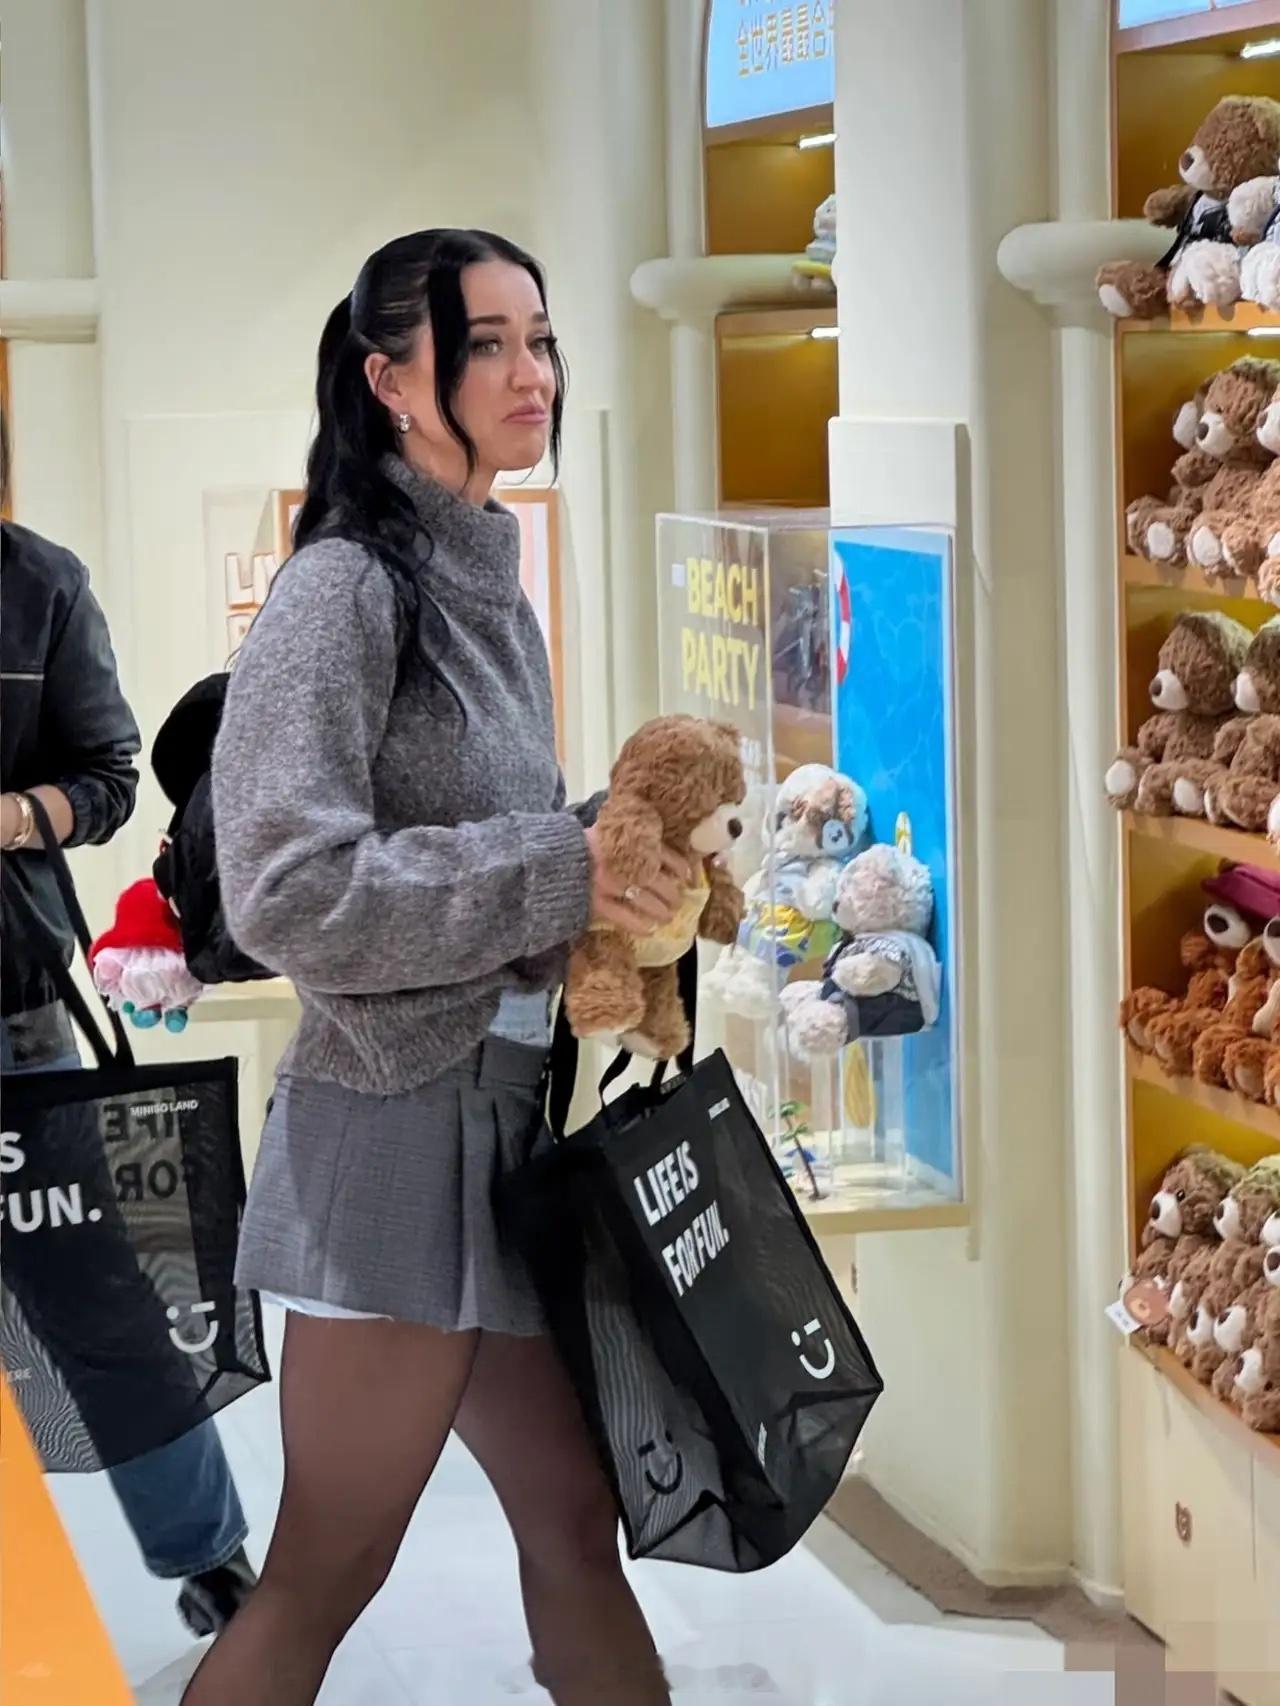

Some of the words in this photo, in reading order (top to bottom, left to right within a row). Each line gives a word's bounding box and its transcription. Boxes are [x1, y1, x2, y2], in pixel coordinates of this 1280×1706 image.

[686, 557, 759, 626] BEACH
[682, 627, 759, 711] PARTY
[169, 1099, 199, 1112] LAND
[0, 1182, 103, 1233] UN.
[633, 1152, 685, 1227] LIFE
[676, 1140, 700, 1195] IS
[661, 1227, 701, 1297] FOR
[692, 1200, 731, 1270] FUN.
